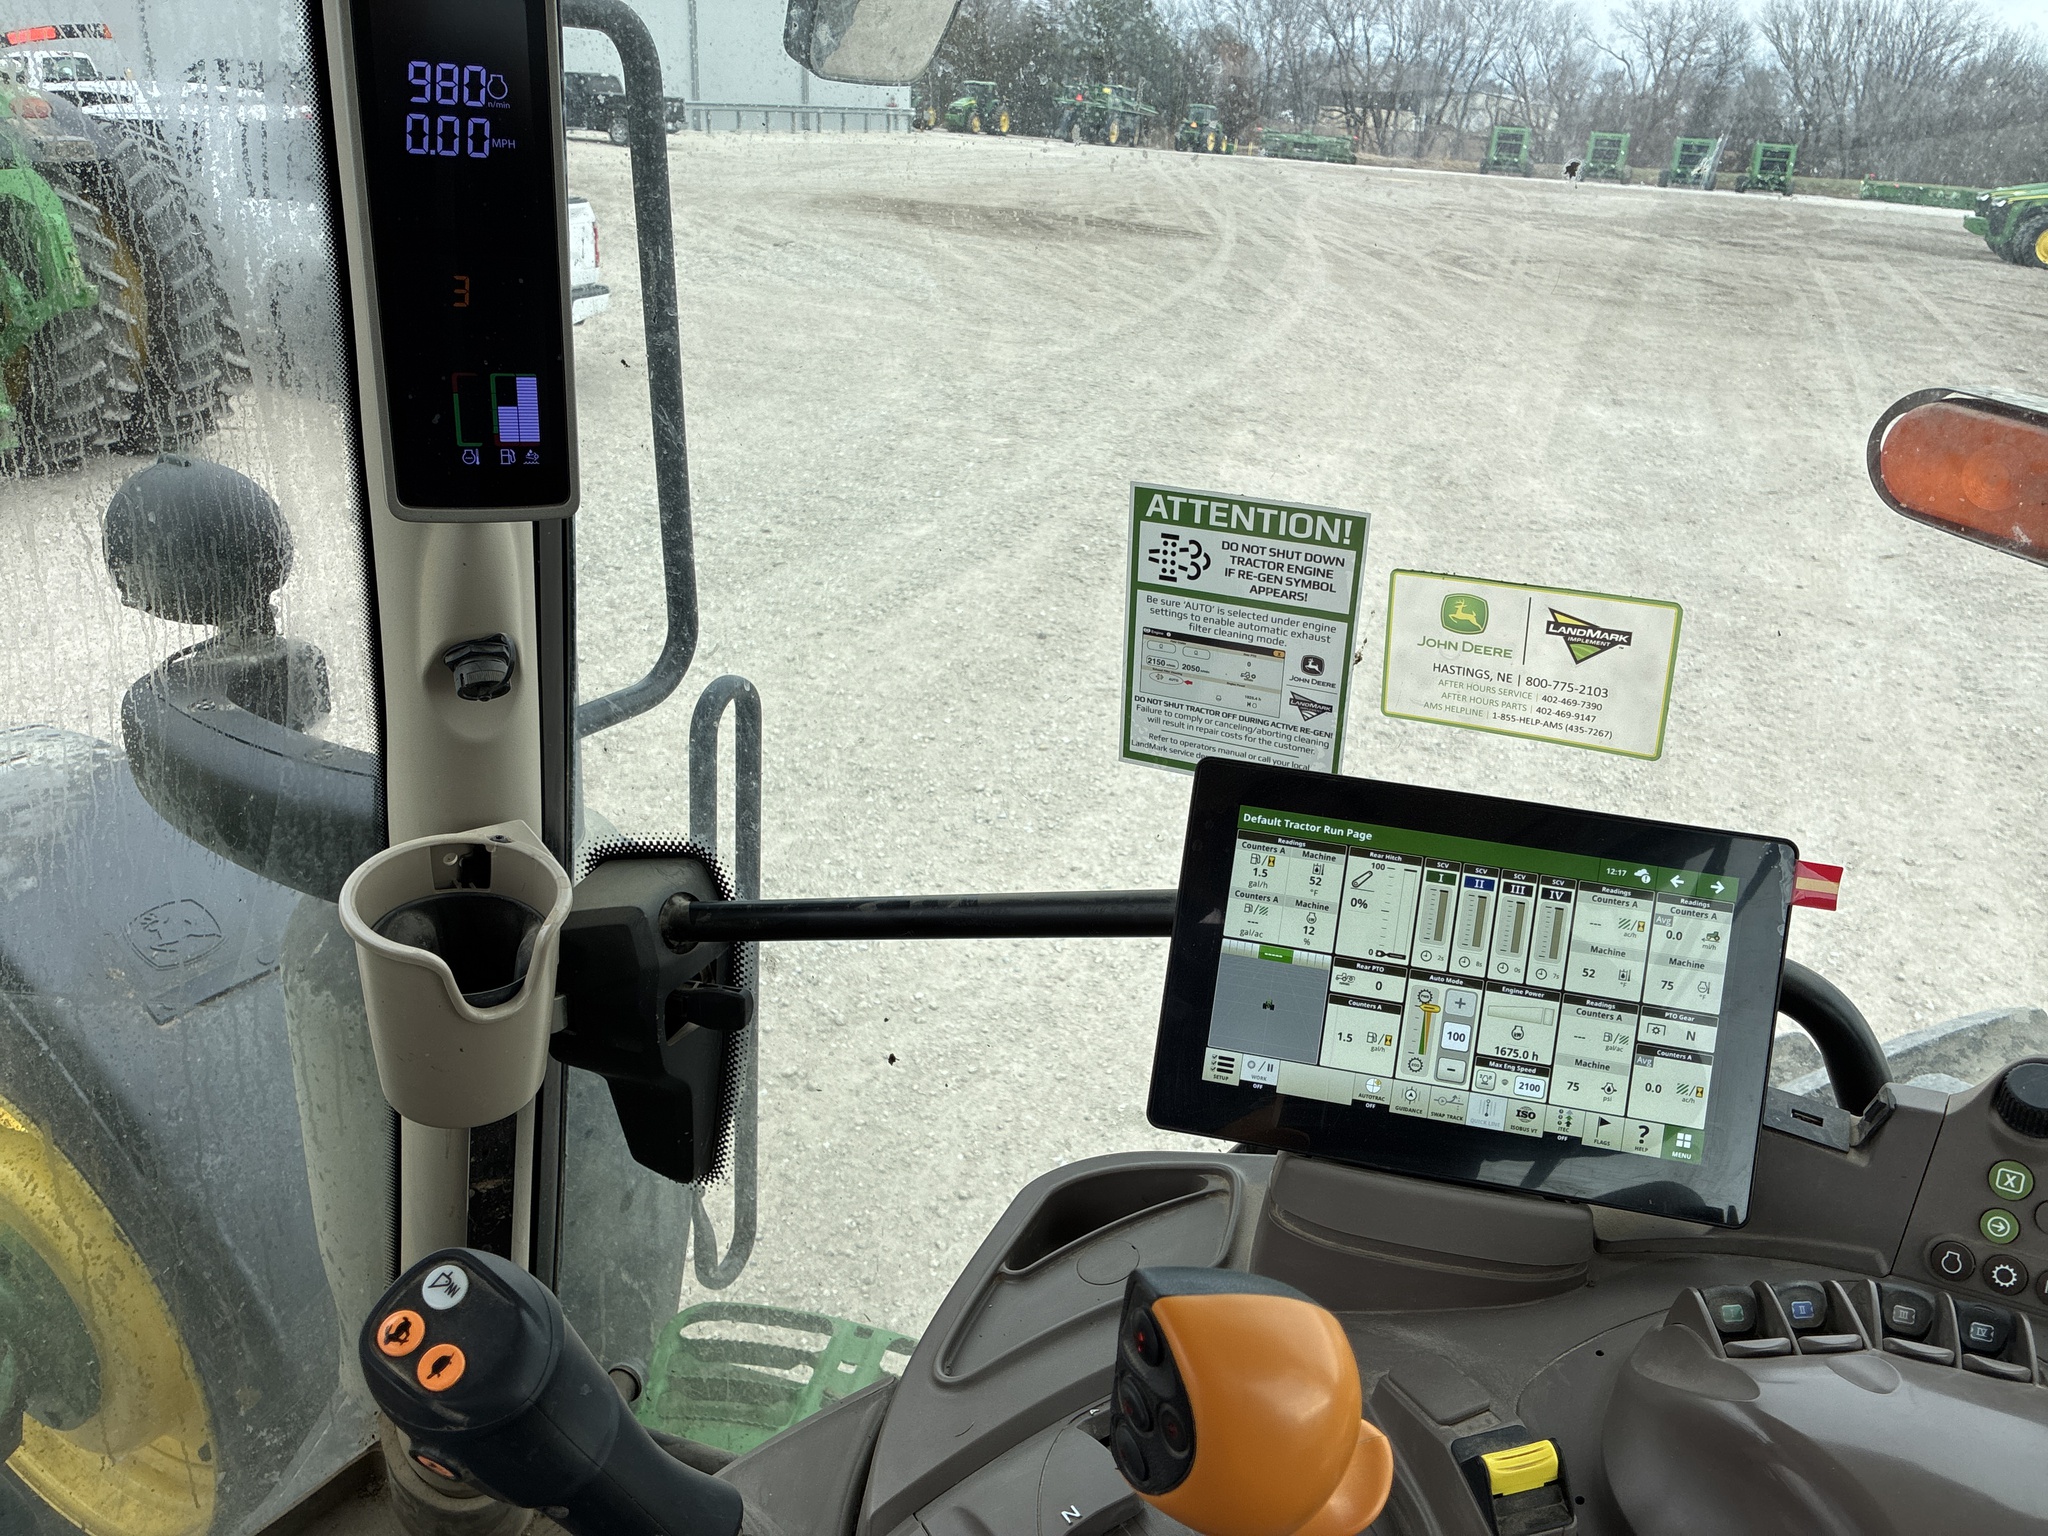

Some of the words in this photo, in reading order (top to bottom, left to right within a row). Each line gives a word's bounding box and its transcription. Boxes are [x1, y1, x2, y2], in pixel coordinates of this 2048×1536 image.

[408, 61, 487, 107] 980
[406, 113, 490, 158] 0.00
[492, 139, 516, 149] MPH
[453, 276, 470, 307] 3
[1145, 494, 1353, 545] ATTENTION!
[1222, 540, 1239, 552] DO
[1241, 543, 1265, 555] NOT
[1269, 547, 1302, 561] SHUT
[1304, 553, 1345, 567] DOWN
[1230, 555, 1284, 572] TRACTOR
[1287, 564, 1334, 579] ENGINE
[1225, 568, 1235, 577] IF
[1238, 570, 1283, 585] RE-GEN
[1286, 577, 1336, 593] SYMBOL
[1249, 585, 1308, 602] APPEARS!
[1146, 595, 1158, 604] Be
[1161, 599, 1181, 608] sure
[1217, 606, 1225, 615] is
[1227, 608, 1268, 622] selected
[1271, 615, 1300, 628] under
[1302, 621, 1337, 634] engine
[1150, 607, 1188, 621] settings
[1191, 613, 1201, 622] to
[1203, 615, 1236, 628] enable
[1237, 621, 1288, 637] automatic
[1291, 629, 1331, 643] exhaust
[1189, 623, 1212, 634] filter
[1214, 627, 1254, 643] cleaning
[1256, 634, 1288, 647] mode.
[1568, 636, 1611, 647] IMPLEMENT
[1148, 658, 1166, 667] 2150
[1182, 664, 1200, 672] 2050
[1432, 662, 1493, 682] HASTINGS,
[1497, 672, 1513, 684] NE
[1526, 676, 1609, 698] 800-775-2103
[1438, 679, 1464, 689] AFTER
[1466, 682, 1496, 694] HOURS
[1498, 687, 1533, 700] SERVICE
[1542, 694, 1602, 711] 402-469-7390
[1442, 692, 1468, 702] AFTER
[1470, 696, 1500, 707] HOURS
[1501, 700, 1527, 712] PARTS
[1536, 706, 1597, 723] 402-469-9147
[1134, 695, 1145, 703] DO
[1147, 698, 1162, 707] NOT
[1164, 701, 1185, 710] SHUT
[1186, 704, 1220, 717] TRACTOR
[1221, 711, 1237, 720] OFF
[1238, 713, 1269, 726] DURING
[1270, 720, 1299, 733] ACTIVE
[1300, 726, 1334, 739] RE-GEN!
[1423, 701, 1443, 711] AMS
[1444, 704, 1483, 718] HELPLINE
[1492, 712, 1563, 730] 1-855-HELP-AMS
[1565, 723, 1613, 740] (435-7267)
[1136, 704, 1162, 716] Failure
[1174, 712, 1203, 725] comply
[1214, 718, 1292, 742] canceling/aborting
[1294, 735, 1330, 749] cleaning
[1147, 716, 1160, 725] will
[1162, 719, 1186, 730] result
[1196, 725, 1219, 738] repair
[1221, 730, 1243, 740] costs
[1244, 733, 1257, 743] for
[1258, 736, 1272, 746] the
[1274, 740, 1316, 755] customer.
[1131, 739, 1168, 752] LandMark
[1169, 748, 1194, 759] service
[1149, 733, 1168, 744] Refer
[1179, 739, 1216, 753] operators
[1218, 746, 1246, 758] manual
[1258, 753, 1271, 763] call
[1273, 757, 1290, 768] your
[1292, 760, 1310, 771] local
[1243, 813, 1282, 828] Default
[1285, 819, 1321, 833] Tractor
[1323, 825, 1344, 836] Run
[1347, 828, 1373, 841] Page
[1241, 841, 1278, 854] Counters
[1278, 838, 1306, 848] Readings
[1302, 851, 1337, 863] Machine
[1370, 852, 1385, 860] Rear
[1387, 853, 1403, 862] Hitch
[1371, 863, 1386, 871] 100
[1606, 867, 1627, 877] 12:17
[1252, 868, 1268, 878] 1.5
[1513, 873, 1526, 881] SCV
[1309, 877, 1322, 887] 52
[1474, 879, 1485, 888] II
[1510, 885, 1526, 895] III
[1549, 890, 1565, 901] IV
[1602, 887, 1632, 897] Readings
[1234, 890, 1271, 903] Counters
[1592, 895, 1630, 907] Counters
[1295, 900, 1330, 912] Machine
[1350, 898, 1368, 910] 0%
[1680, 898, 1711, 909] Readings
[1670, 907, 1709, 919] Counters
[1656, 916, 1672, 927] Avg
[1303, 926, 1315, 936] 12
[1666, 930, 1683, 941] 0.0
[1590, 945, 1626, 958] Machine
[1356, 963, 1371, 971] Rear
[1669, 957, 1705, 970] Machine
[1582, 968, 1596, 978] 52
[1429, 974, 1445, 982] Auto
[1446, 977, 1464, 985] Mode
[1661, 980, 1674, 991] 75
[1502, 986, 1525, 996] Engine
[1526, 990, 1545, 998] Power
[1348, 1000, 1377, 1010] Counters
[1586, 1000, 1616, 1010] Readings
[1576, 1008, 1614, 1020] Counters
[1665, 1012, 1678, 1020] PTO
[1337, 1032, 1353, 1043] 1.5
[1447, 1032, 1466, 1043] 100
[1494, 1046, 1529, 1060] 1675.0
[1657, 1050, 1686, 1060] Counters
[1575, 1059, 1611, 1071] Machine
[1636, 1056, 1652, 1067] Avg
[1502, 1064, 1514, 1072] Eng
[1515, 1066, 1537, 1075] Speed
[1213, 1074, 1229, 1082] SETUP
[1518, 1082, 1541, 1093] 2100
[1567, 1081, 1580, 1091] 75
[1645, 1083, 1662, 1094] 0.0
[1358, 1093, 1386, 1102] AUTOTRAC
[1395, 1106, 1423, 1115] GUIDANCE
[1516, 1110, 1536, 1120] ISO
[1431, 1111, 1446, 1119] SWAP
[1447, 1114, 1464, 1122] TRACK
[1510, 1125, 1528, 1133] ISOBUS
[1593, 1139, 1611, 1147] FLAGS
[1672, 1152, 1691, 1160] MENU
